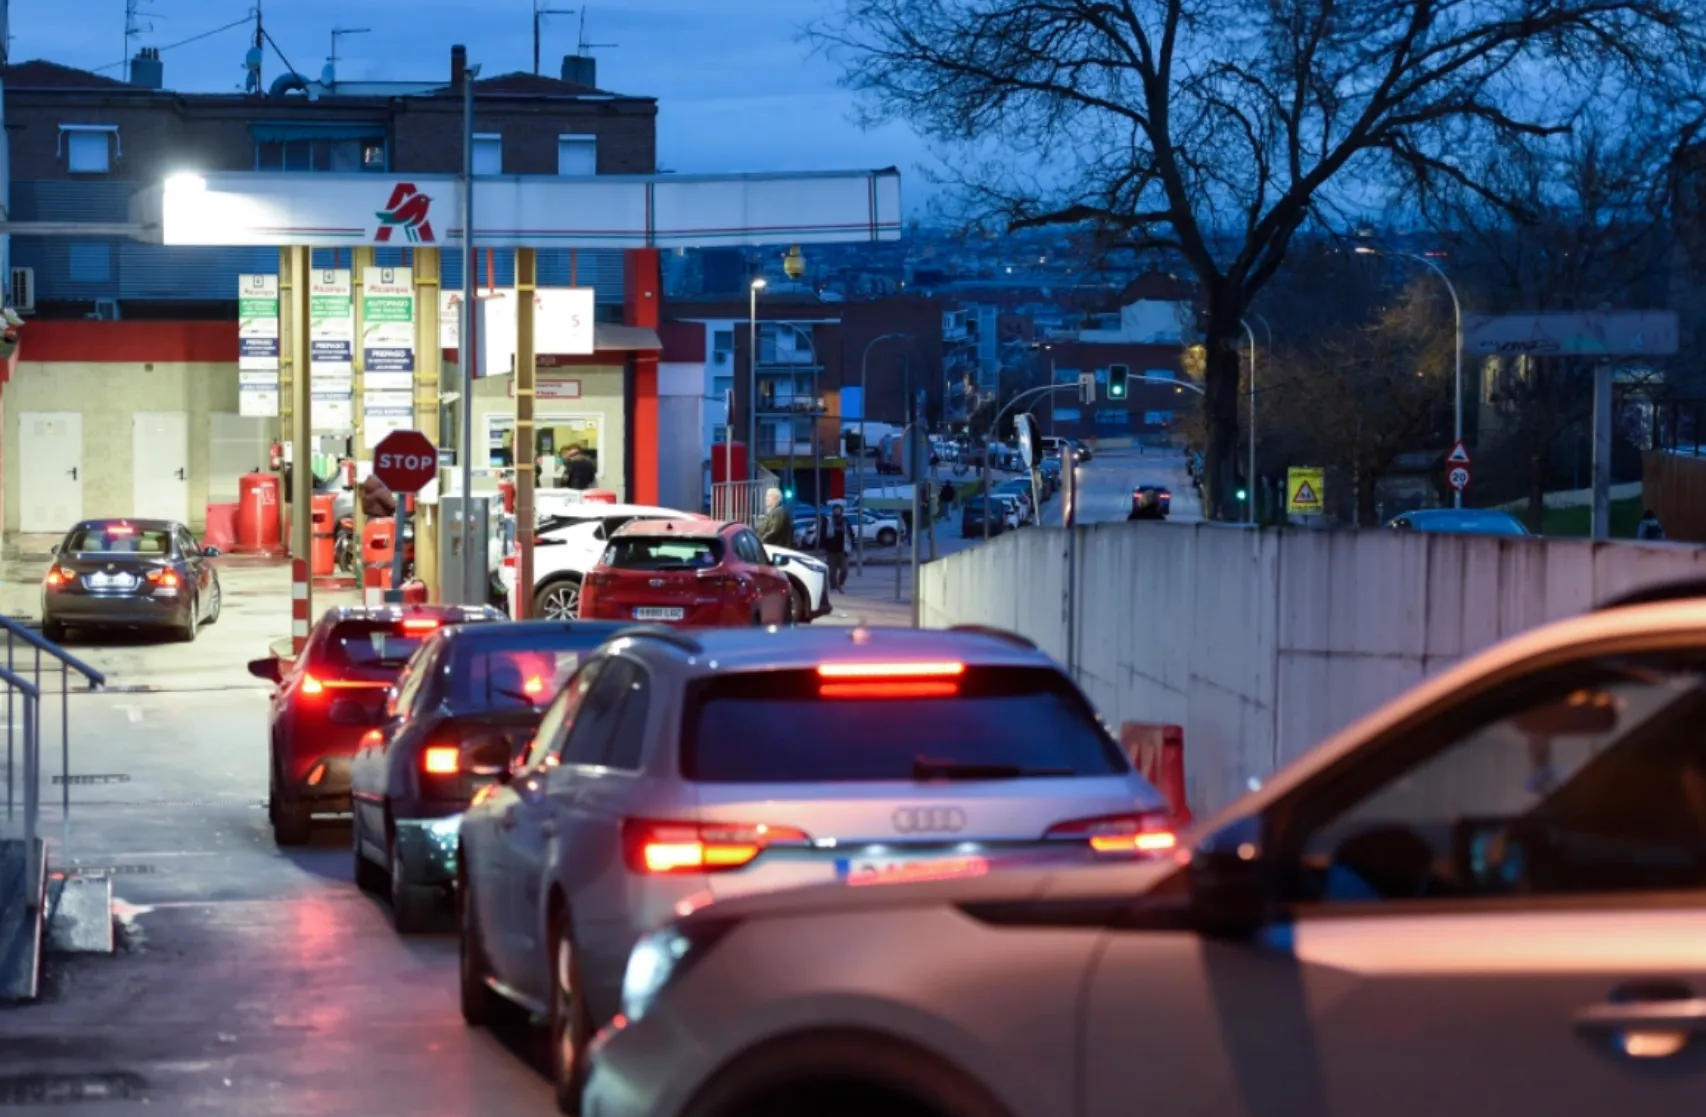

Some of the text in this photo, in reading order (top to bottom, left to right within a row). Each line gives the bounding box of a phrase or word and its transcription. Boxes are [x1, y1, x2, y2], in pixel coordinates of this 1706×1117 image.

[570, 314, 581, 328] 5
[379, 453, 433, 471] STOP
[1452, 472, 1466, 482] 20
